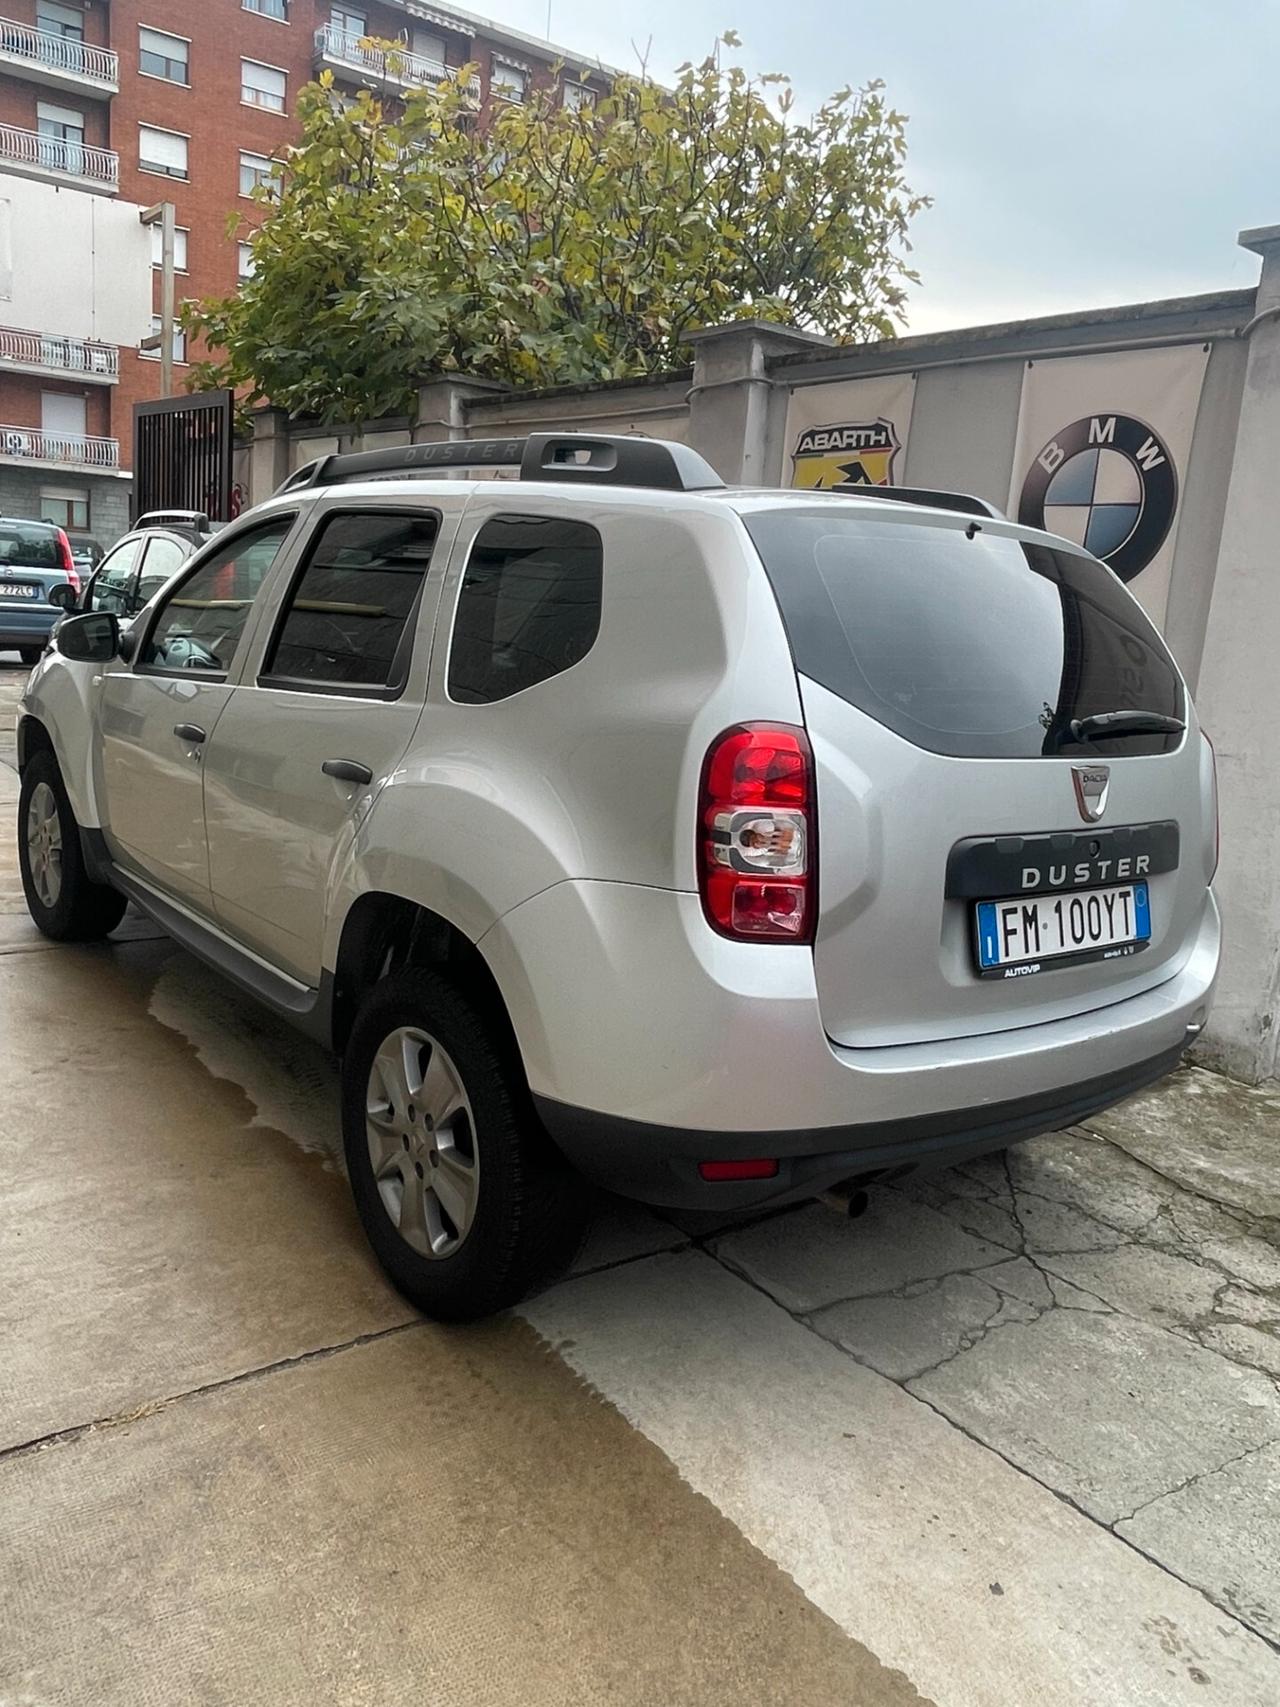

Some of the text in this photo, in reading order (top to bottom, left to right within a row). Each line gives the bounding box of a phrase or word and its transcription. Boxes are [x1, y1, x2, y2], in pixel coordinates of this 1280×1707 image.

[404, 444, 518, 462] DUSTER
[800, 430, 886, 451] ABARTH
[1038, 417, 1165, 474] BMW
[1022, 855, 1149, 888] DUSTER
